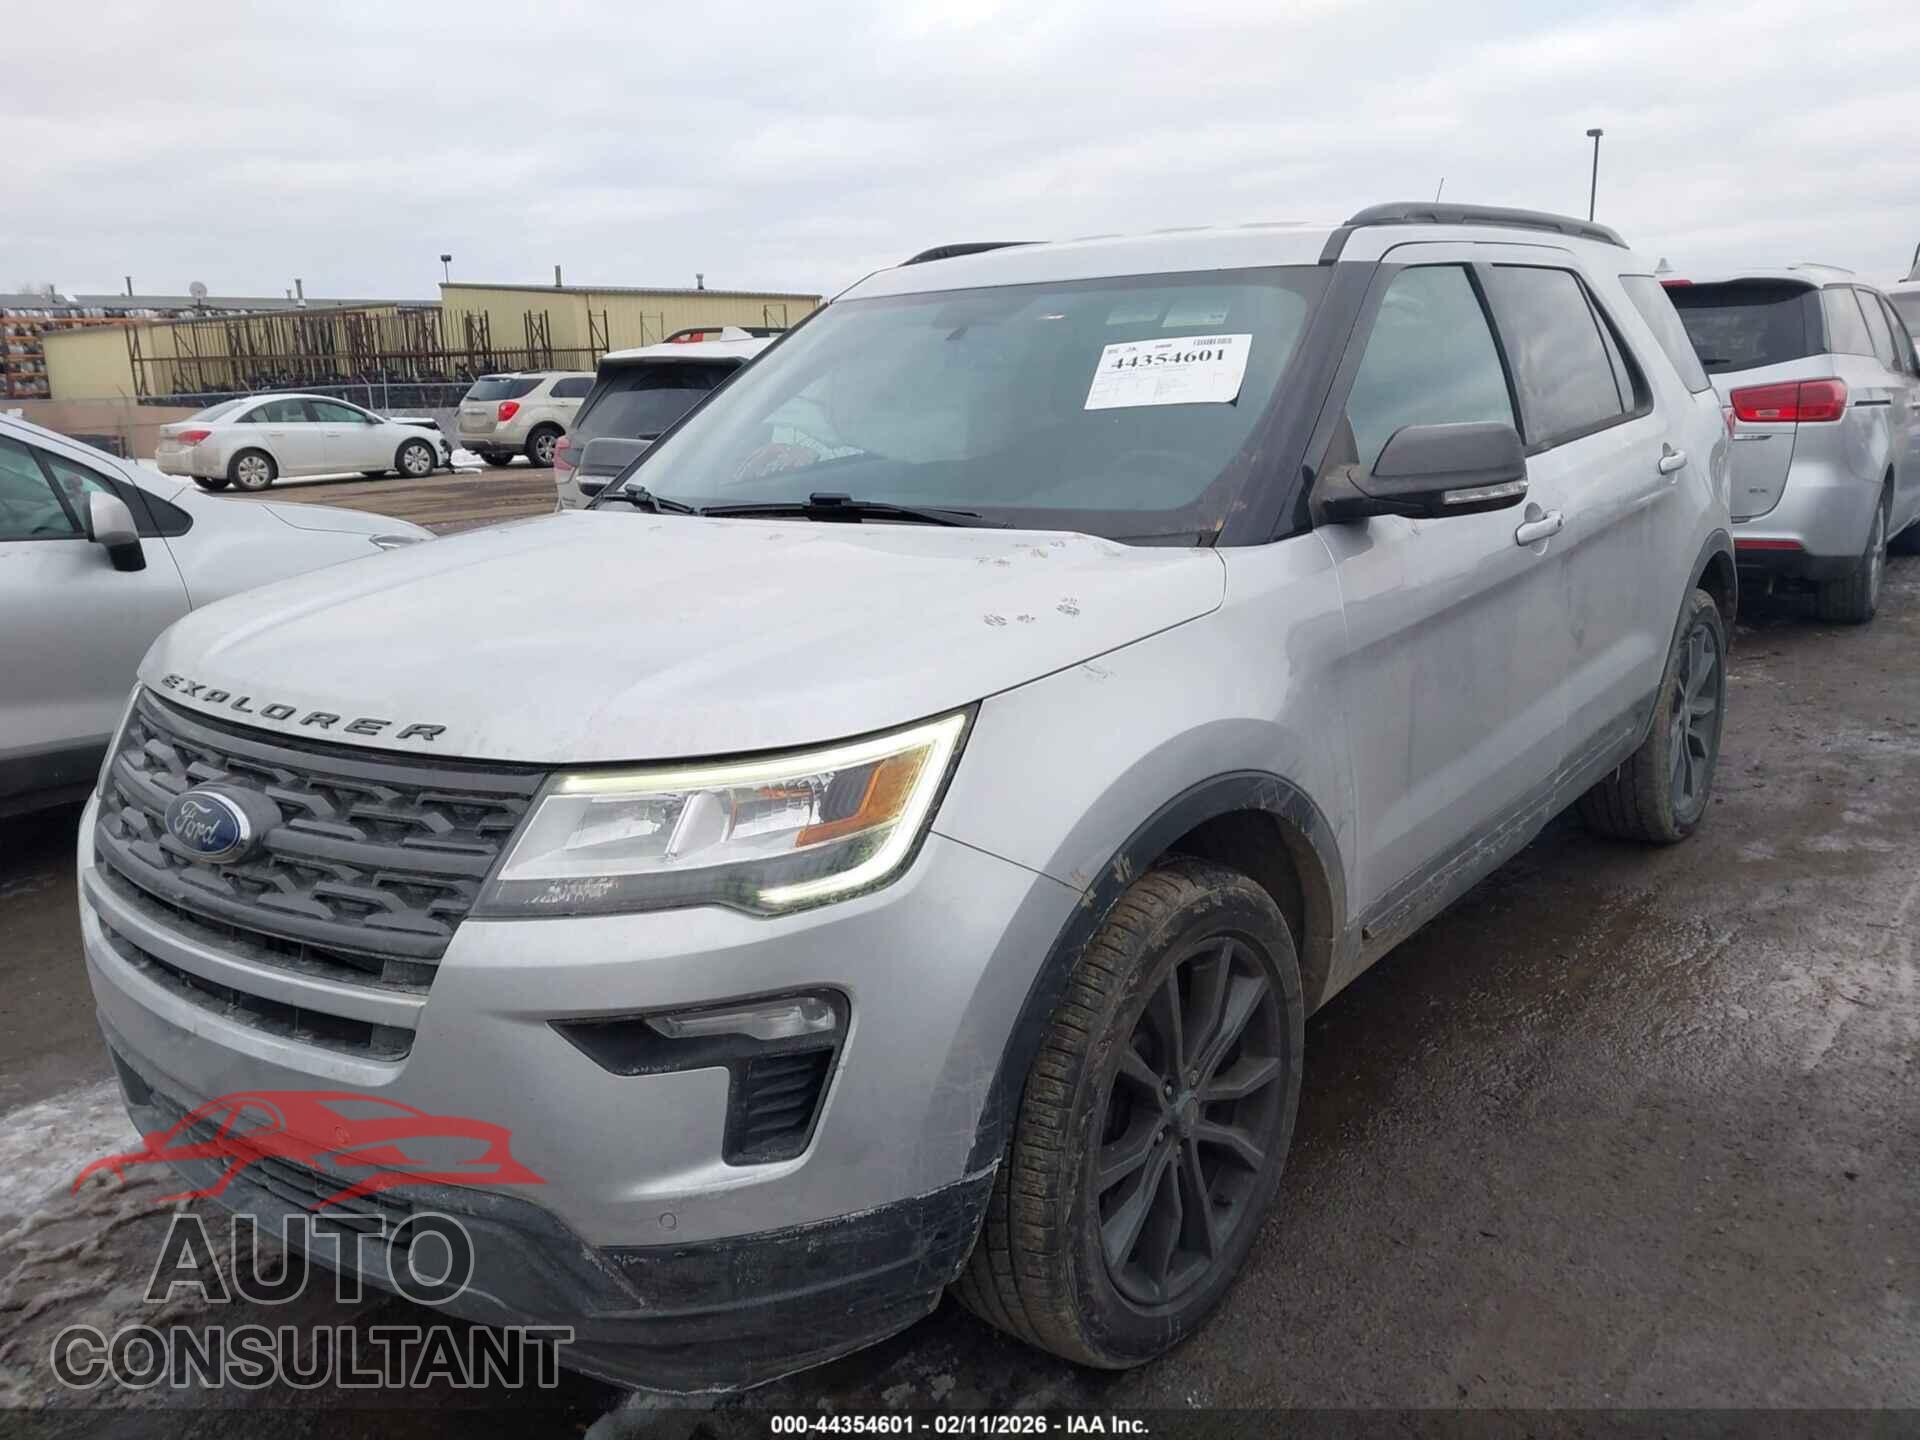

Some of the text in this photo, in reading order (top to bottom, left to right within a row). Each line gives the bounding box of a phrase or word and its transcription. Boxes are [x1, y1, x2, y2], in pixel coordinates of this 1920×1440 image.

[1111, 349, 1225, 369] 44354601
[161, 673, 448, 741] EXPLORER
[174, 800, 220, 846] Ford
